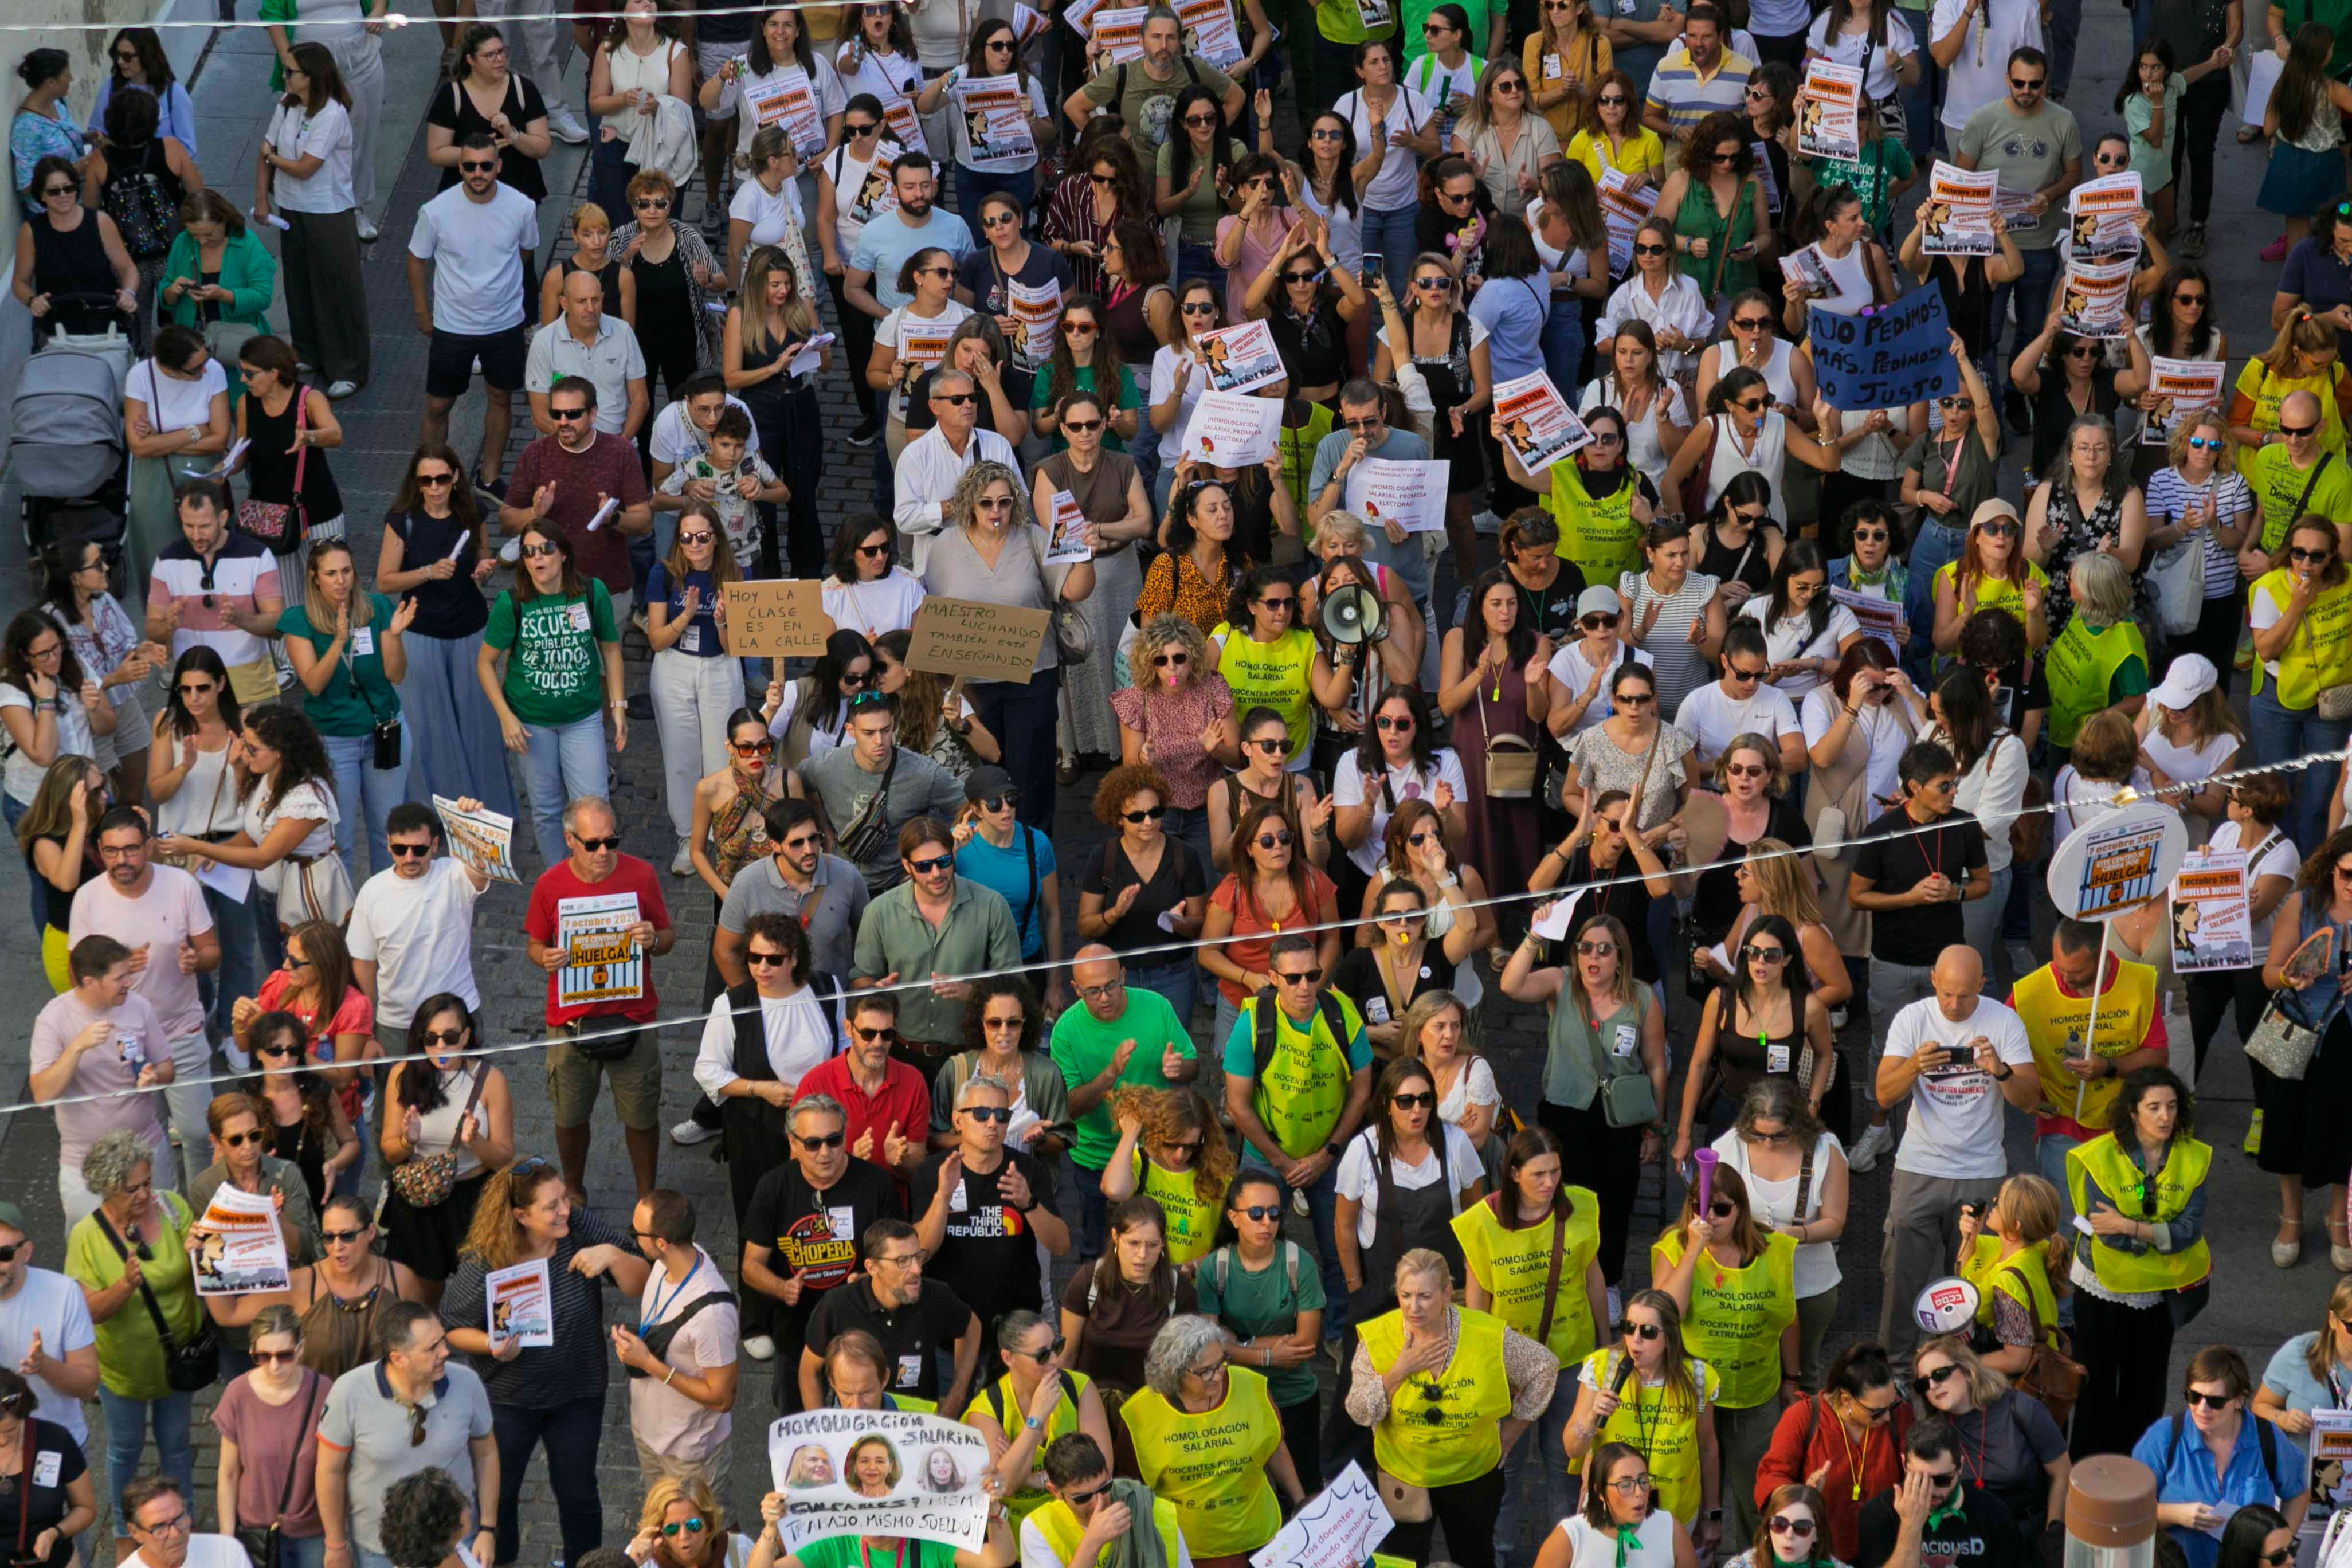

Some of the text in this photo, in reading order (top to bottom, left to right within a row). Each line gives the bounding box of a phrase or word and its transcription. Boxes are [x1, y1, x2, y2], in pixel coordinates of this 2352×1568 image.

[1942, 186, 1969, 196] octubre
[2086, 193, 2113, 203] octubre
[2116, 191, 2135, 199] 2025
[1810, 293, 1941, 346] NO PEDIMOS
[915, 340, 942, 349] octubre
[1870, 345, 1942, 377] PEDIMOS
[1853, 375, 1943, 405] JUSTO
[2166, 378, 2192, 388] octubre
[2194, 378, 2214, 388] 2025
[1207, 417, 1259, 428] ¡HOMOLOGACIÓN
[1371, 483, 1425, 492] ¡HOMOLOGACIÓN
[1400, 492, 1427, 500] PROMESA
[1577, 526, 1614, 536] DOCENTES
[730, 589, 758, 604] HOY
[775, 590, 794, 601] LA
[748, 606, 798, 620] CLASE
[923, 602, 997, 620] MAESTRO
[746, 621, 802, 633] ES EN
[961, 618, 1041, 640] LUCHANDO
[535, 636, 579, 651] PÚBLICA
[739, 633, 821, 649] LA CALLE
[929, 630, 988, 645] TAMBIÉN
[997, 637, 1026, 649] ESTÁ
[927, 644, 1034, 669] ENSEÑANDO
[1235, 660, 1299, 673] HOMOLOGACIÓN
[534, 670, 581, 689] TODOS
[1246, 672, 1286, 682] SALARIAL
[1230, 688, 1300, 697] DOCENTES PÚBLICA
[1237, 697, 1292, 705] EXTREMADURA
[2096, 840, 2134, 854] octubre
[2137, 832, 2162, 845] 2025
[2091, 863, 2147, 887] ¡HUELGA!
[2185, 876, 2217, 887] octubre
[2218, 874, 2240, 885] 2025
[2179, 887, 2210, 899] ¡HUELGA
[563, 912, 637, 928] 7 octubre 2025
[2201, 902, 2247, 924] ¡HOMOLOGACIÓN
[2209, 916, 2233, 929] SALARIAL
[571, 947, 629, 966] ¡HUELGA!
[1938, 1084, 1986, 1095] COTTON GARMENTS
[979, 1206, 1002, 1216] THE
[969, 1216, 1002, 1228] THIRD
[947, 1226, 1002, 1237] REPUBLIC
[790, 1240, 855, 1265] CHOPERA
[1509, 1262, 1549, 1276] SALARIA
[1702, 1288, 1776, 1304] HOMOLOGACIÓN
[1719, 1302, 1766, 1312] SALARIAL
[1699, 1319, 1745, 1330] DOCENTES
[777, 1414, 925, 1438] HOMOLOGACIÓN
[899, 1429, 985, 1447] SALARIAL
[1163, 1422, 1249, 1445] HOMOLOGACIÓN
[1182, 1438, 1235, 1453] SALARIAL
[1167, 1456, 1253, 1476] DOCENTES PÚBLICA
[1179, 1467, 1244, 1482] EXTREMADURA
[866, 1514, 915, 1528] MISMO
[1340, 1507, 1371, 1545] también
[1301, 1507, 1355, 1560] Los docentes
